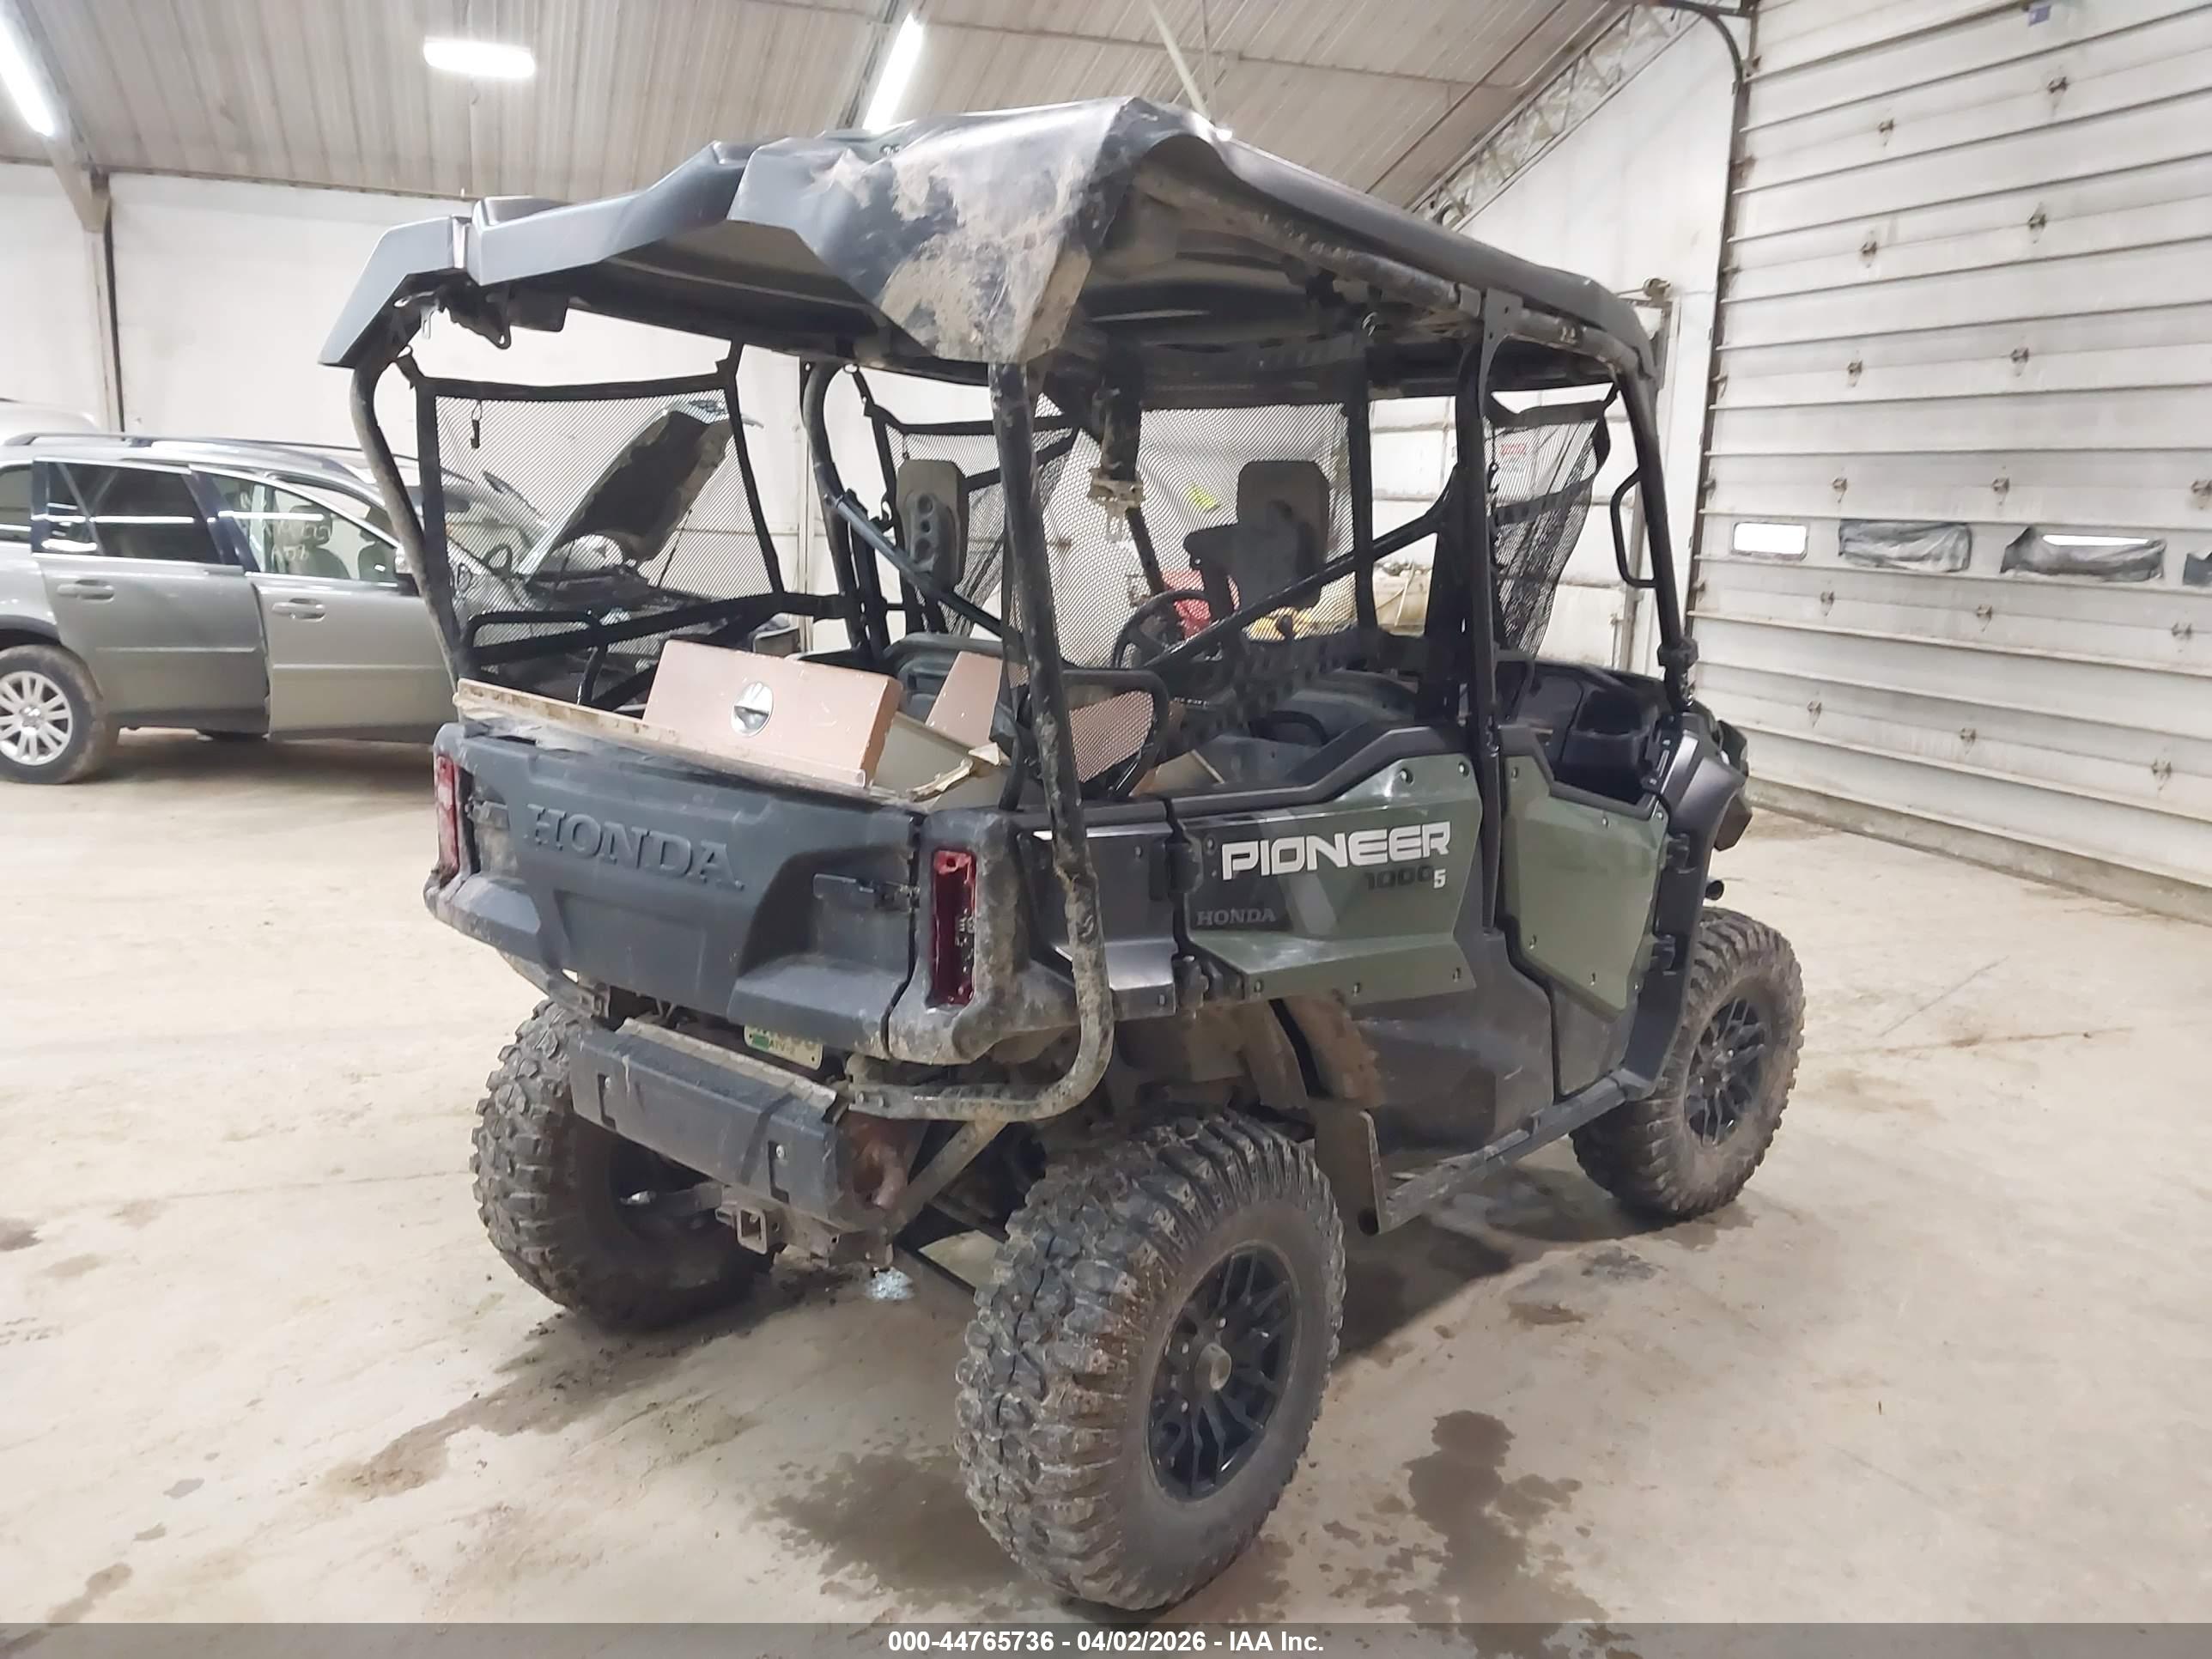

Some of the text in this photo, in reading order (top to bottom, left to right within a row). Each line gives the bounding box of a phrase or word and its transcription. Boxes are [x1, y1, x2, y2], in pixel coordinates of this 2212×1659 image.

[526, 803, 744, 891] HONDA
[1221, 821, 1451, 881] PIONEER
[1433, 868, 1447, 889] 5
[1196, 907, 1277, 927] HONDA
